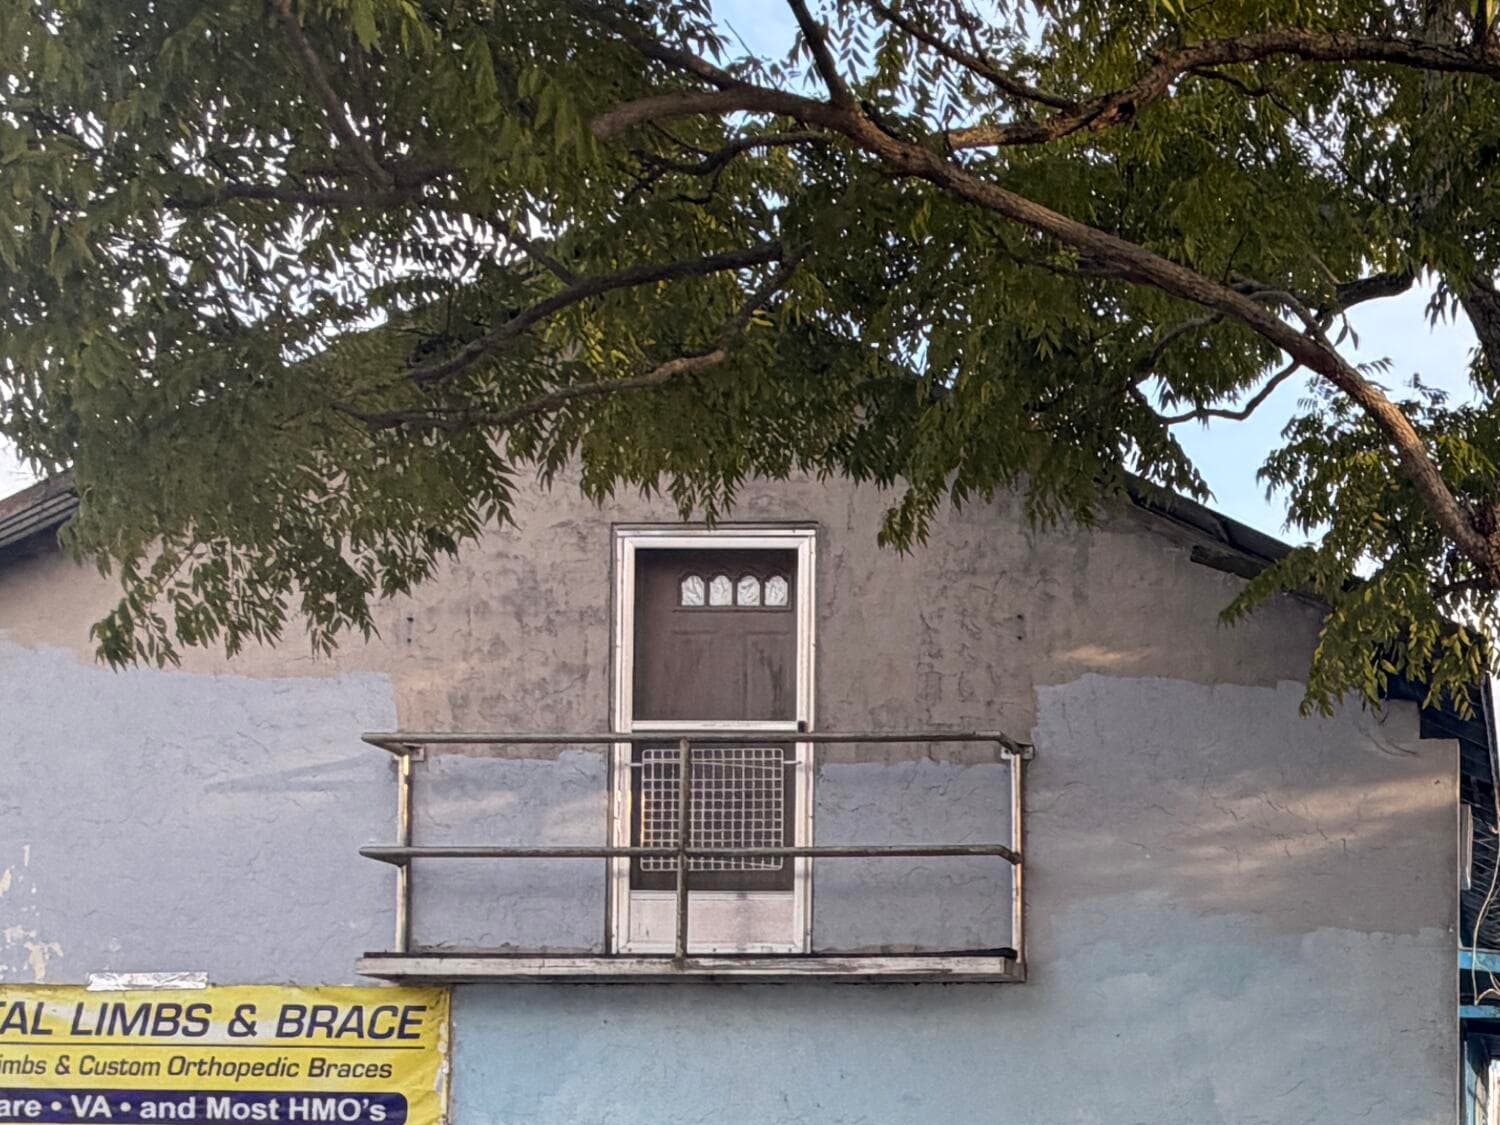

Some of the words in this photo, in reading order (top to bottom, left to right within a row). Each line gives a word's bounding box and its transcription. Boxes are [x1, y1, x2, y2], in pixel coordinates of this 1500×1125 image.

[0, 1001, 53, 1035] AL
[70, 1002, 212, 1037] LIMBS
[227, 1004, 257, 1037] &
[275, 1004, 427, 1039] BRACE
[55, 1055, 71, 1075] &
[79, 1055, 161, 1076] Custom
[167, 1056, 300, 1082] Orthopedic
[308, 1057, 392, 1078] Braces
[70, 1094, 112, 1118] VA
[140, 1096, 196, 1119] and
[206, 1096, 280, 1120] Most
[288, 1097, 387, 1121] HMO's
